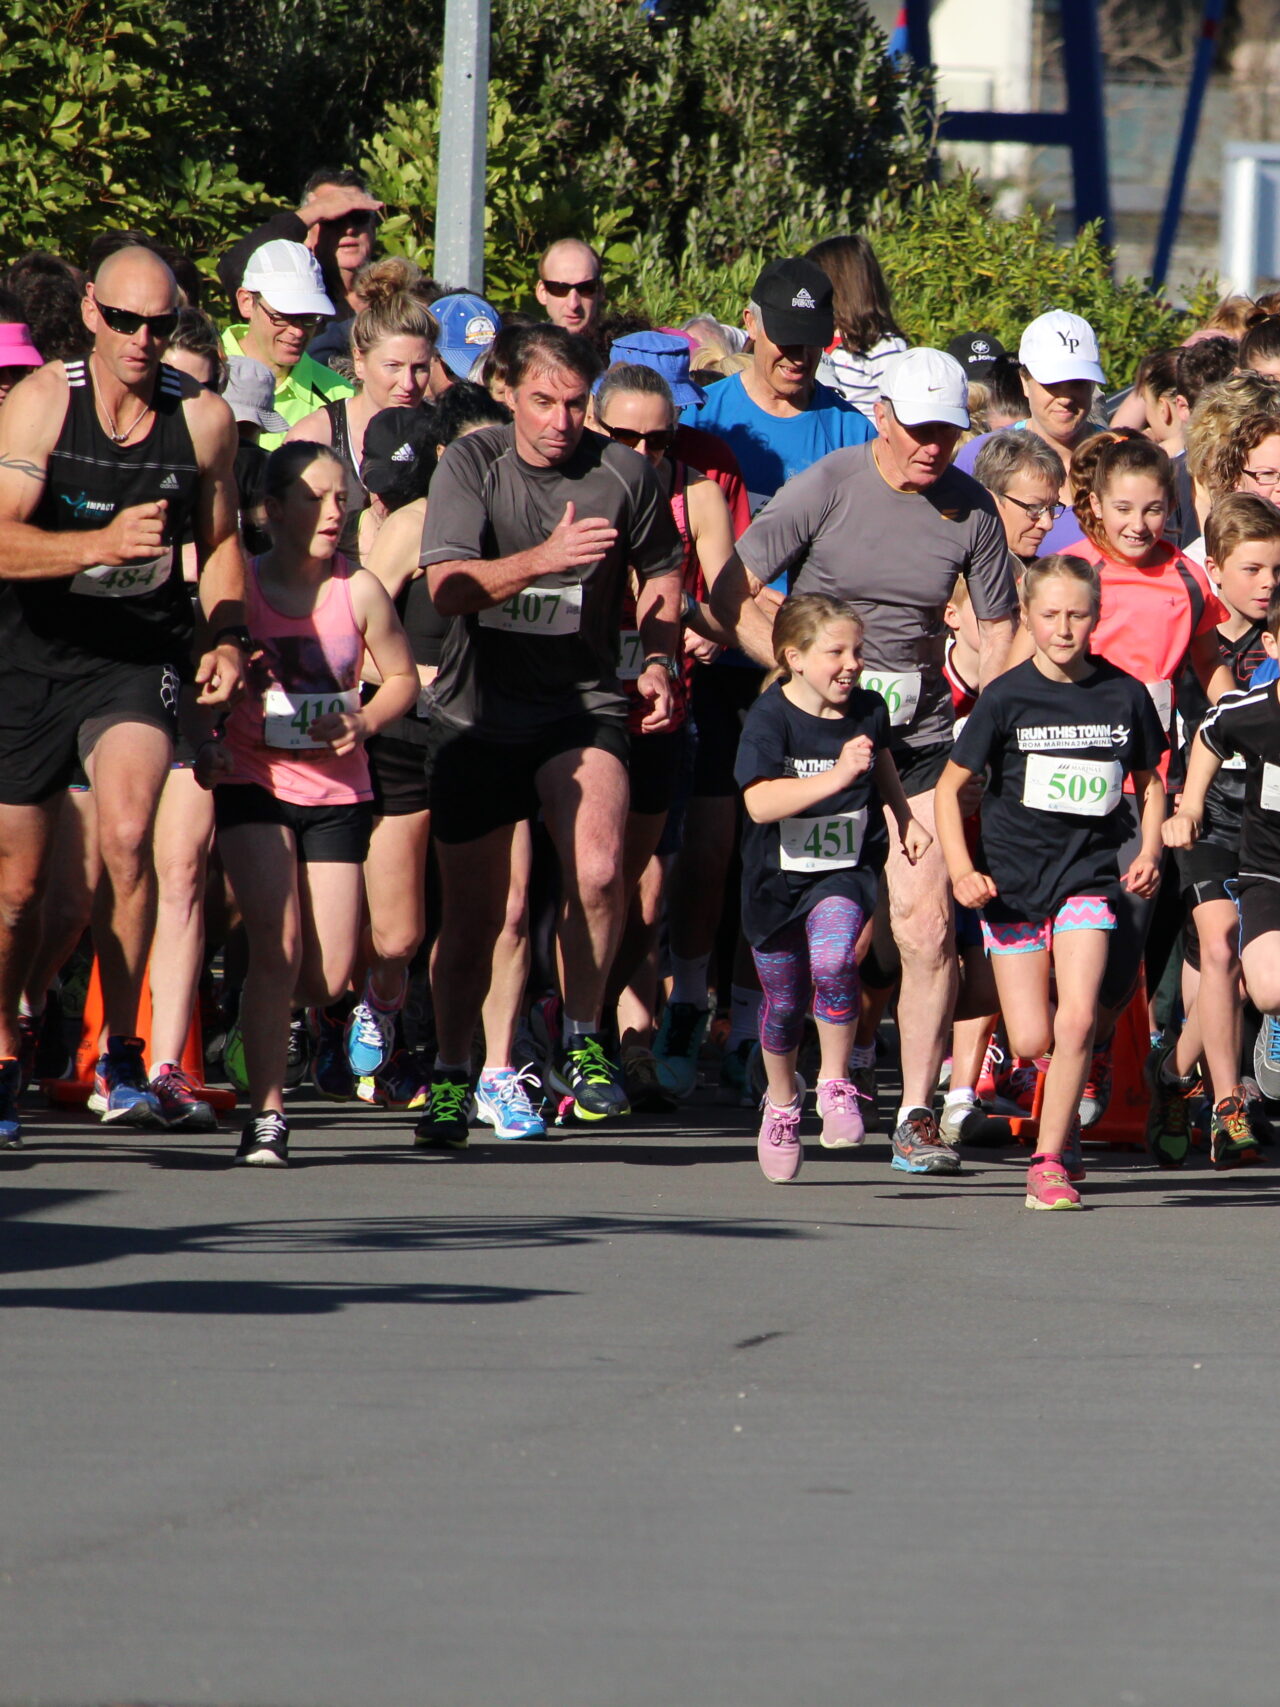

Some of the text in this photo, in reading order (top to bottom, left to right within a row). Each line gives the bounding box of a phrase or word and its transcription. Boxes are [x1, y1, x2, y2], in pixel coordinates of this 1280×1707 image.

[391, 454, 416, 462] adida
[86, 501, 115, 511] IMPACT
[98, 567, 156, 589] 484
[502, 592, 561, 625] 407
[1020, 726, 1047, 740] RUN
[1047, 725, 1076, 739] THIS
[1076, 724, 1111, 738] TOWN
[807, 759, 835, 772] THIS
[1048, 773, 1107, 803] 509
[803, 819, 856, 858] 451
